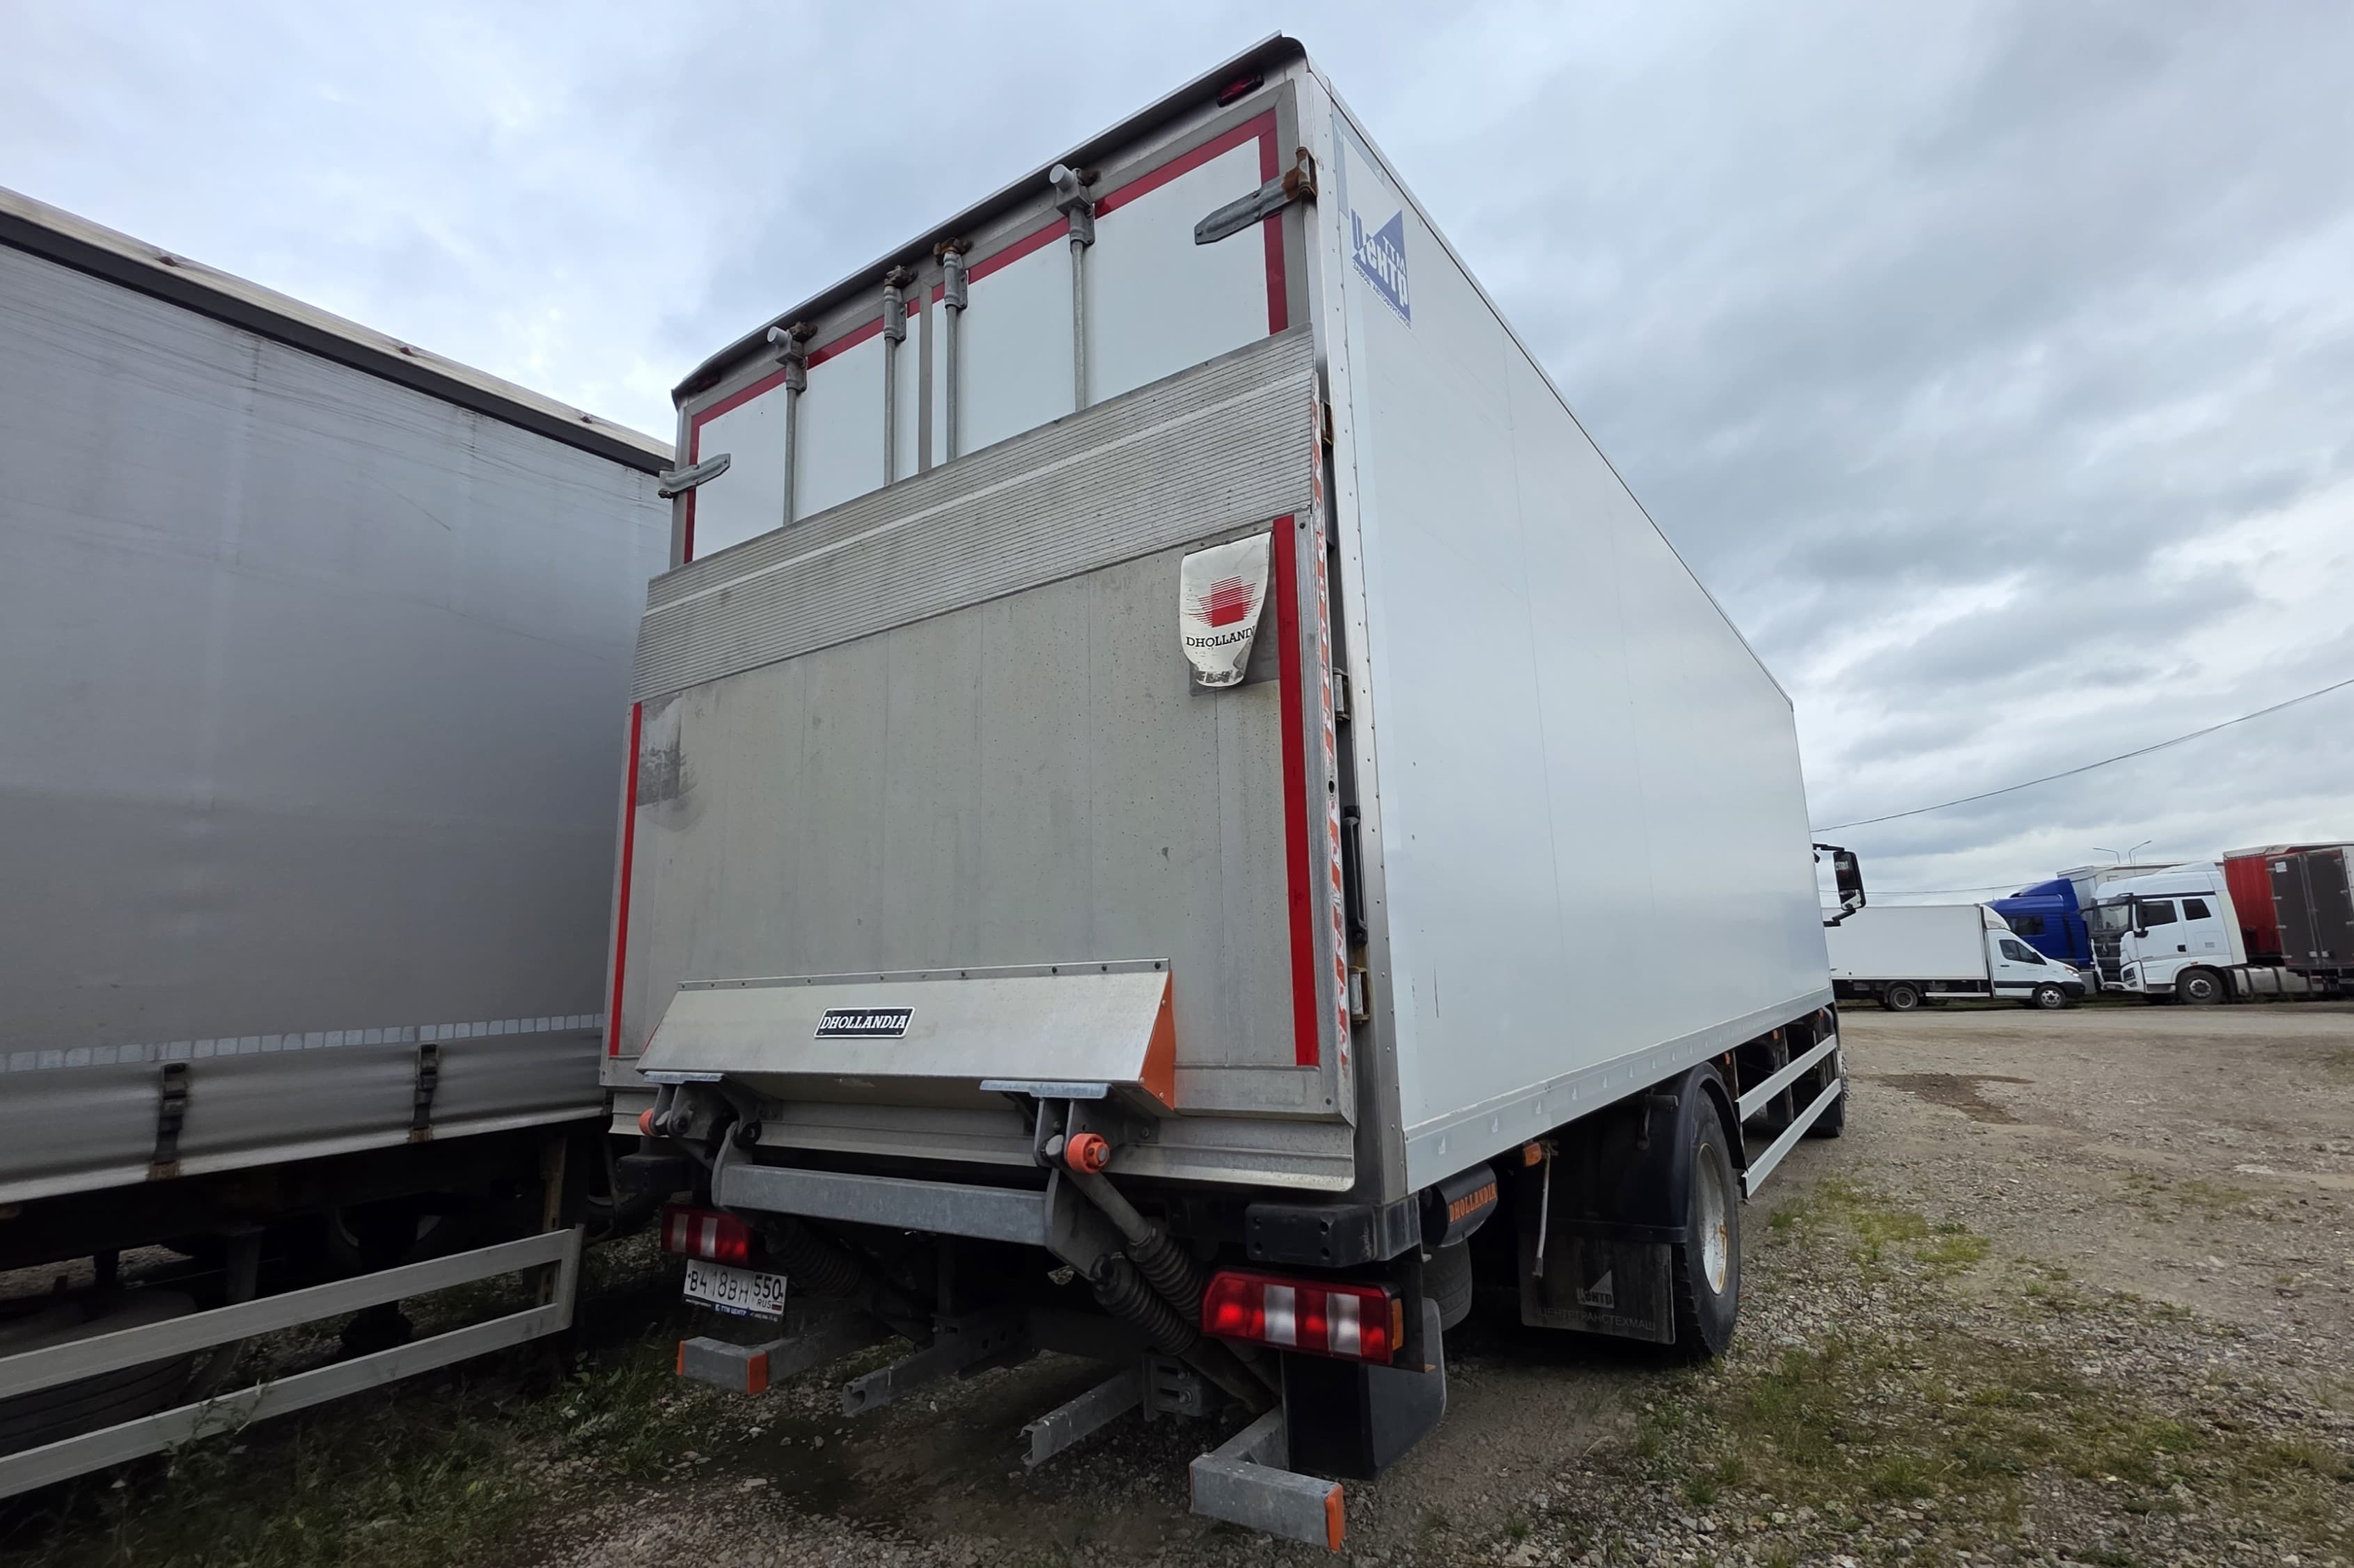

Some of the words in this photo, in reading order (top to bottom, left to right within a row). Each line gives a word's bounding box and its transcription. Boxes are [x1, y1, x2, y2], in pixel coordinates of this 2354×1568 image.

[1383, 235, 1406, 275] ТТМ
[1186, 625, 1255, 648] DHOLLAND
[819, 1015, 908, 1029] DHOLLANDIA
[1449, 1182, 1496, 1223] DHOLLANDIA
[753, 1273, 781, 1301] 550
[757, 1299, 771, 1309] RUS
